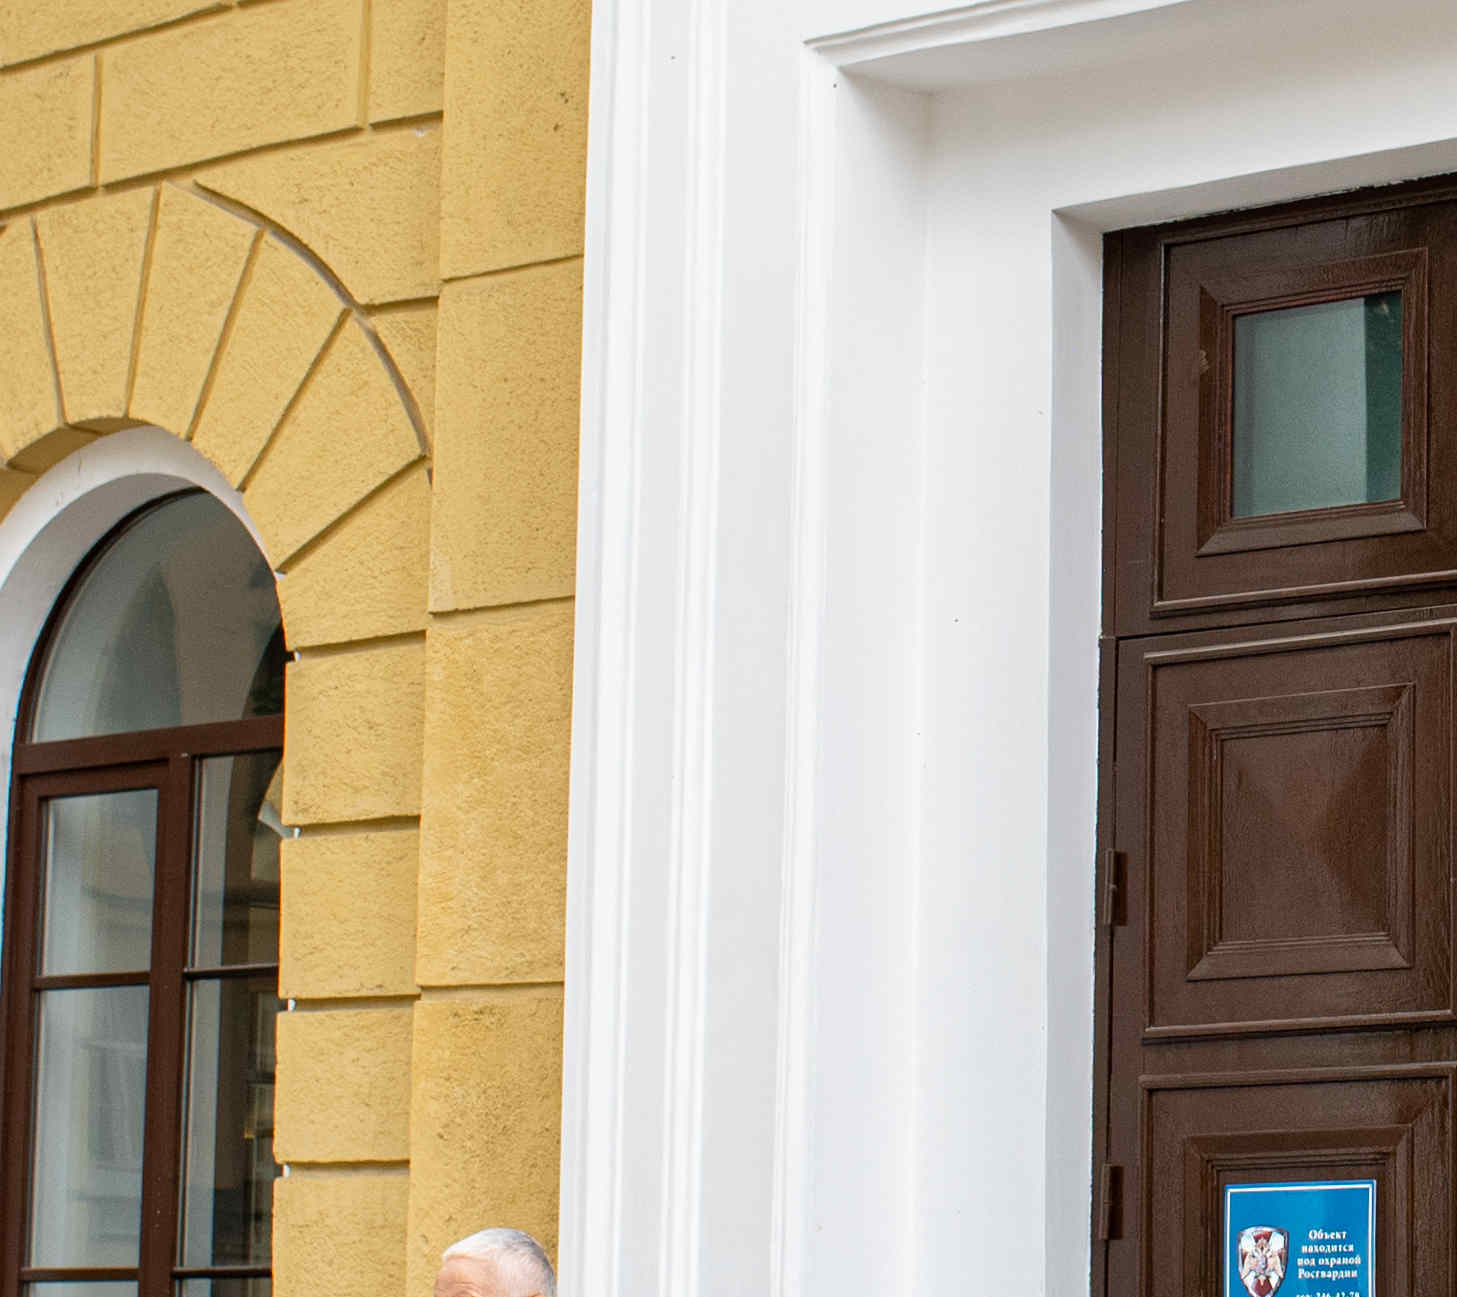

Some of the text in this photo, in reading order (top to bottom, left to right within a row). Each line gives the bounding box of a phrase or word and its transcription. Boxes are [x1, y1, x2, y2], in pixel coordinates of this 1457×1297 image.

[1308, 1229, 1347, 1240] Объект
[1301, 1244, 1354, 1254] находится
[1297, 1254, 1361, 1268] под охраной
[1298, 1268, 1358, 1281] Росгвардии
